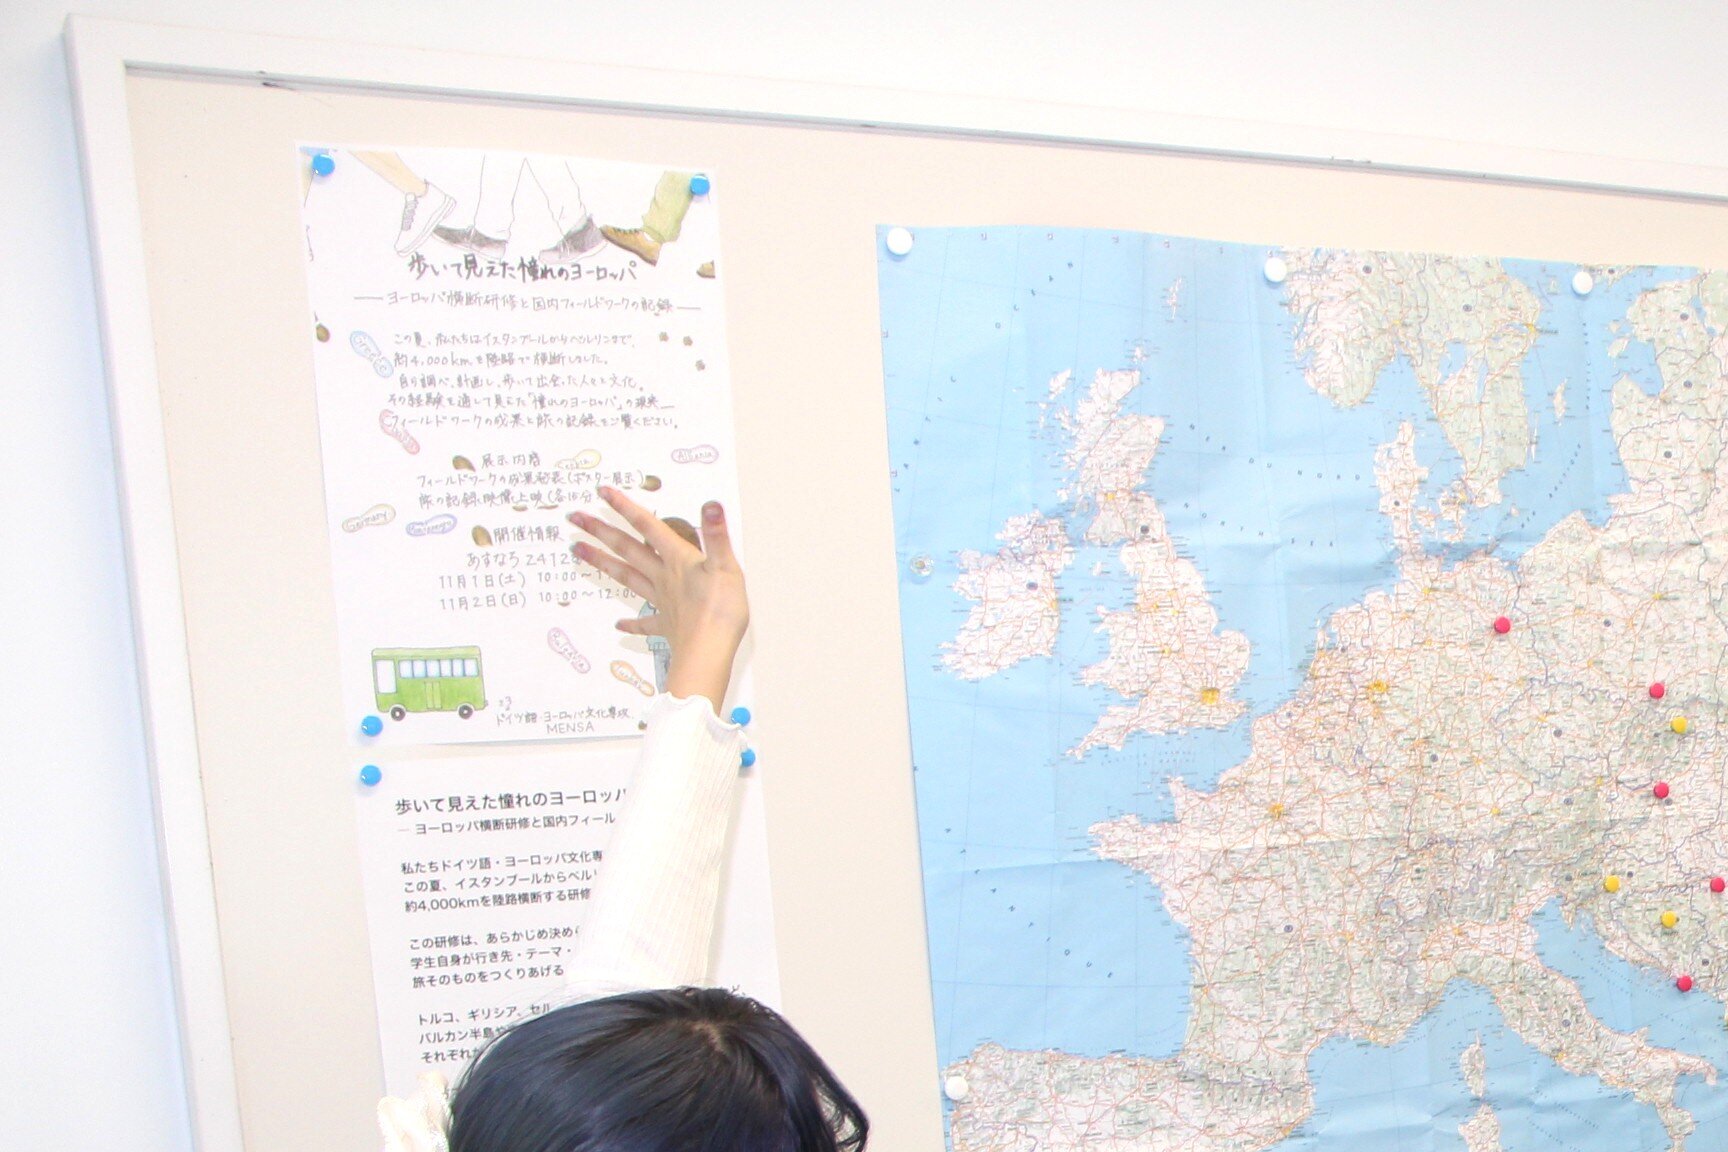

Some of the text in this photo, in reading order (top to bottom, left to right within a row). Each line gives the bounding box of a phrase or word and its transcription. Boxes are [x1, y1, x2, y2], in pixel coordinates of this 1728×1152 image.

[408, 251, 638, 283] 歩いて見えた憧れのヨーロッパ
[493, 525, 565, 545] 開催情報
[546, 721, 595, 735] MENSA
[404, 887, 592, 913] 約4,000kmを陸路横断する研修
[412, 963, 565, 989] 旅そのものをつくりあげる
